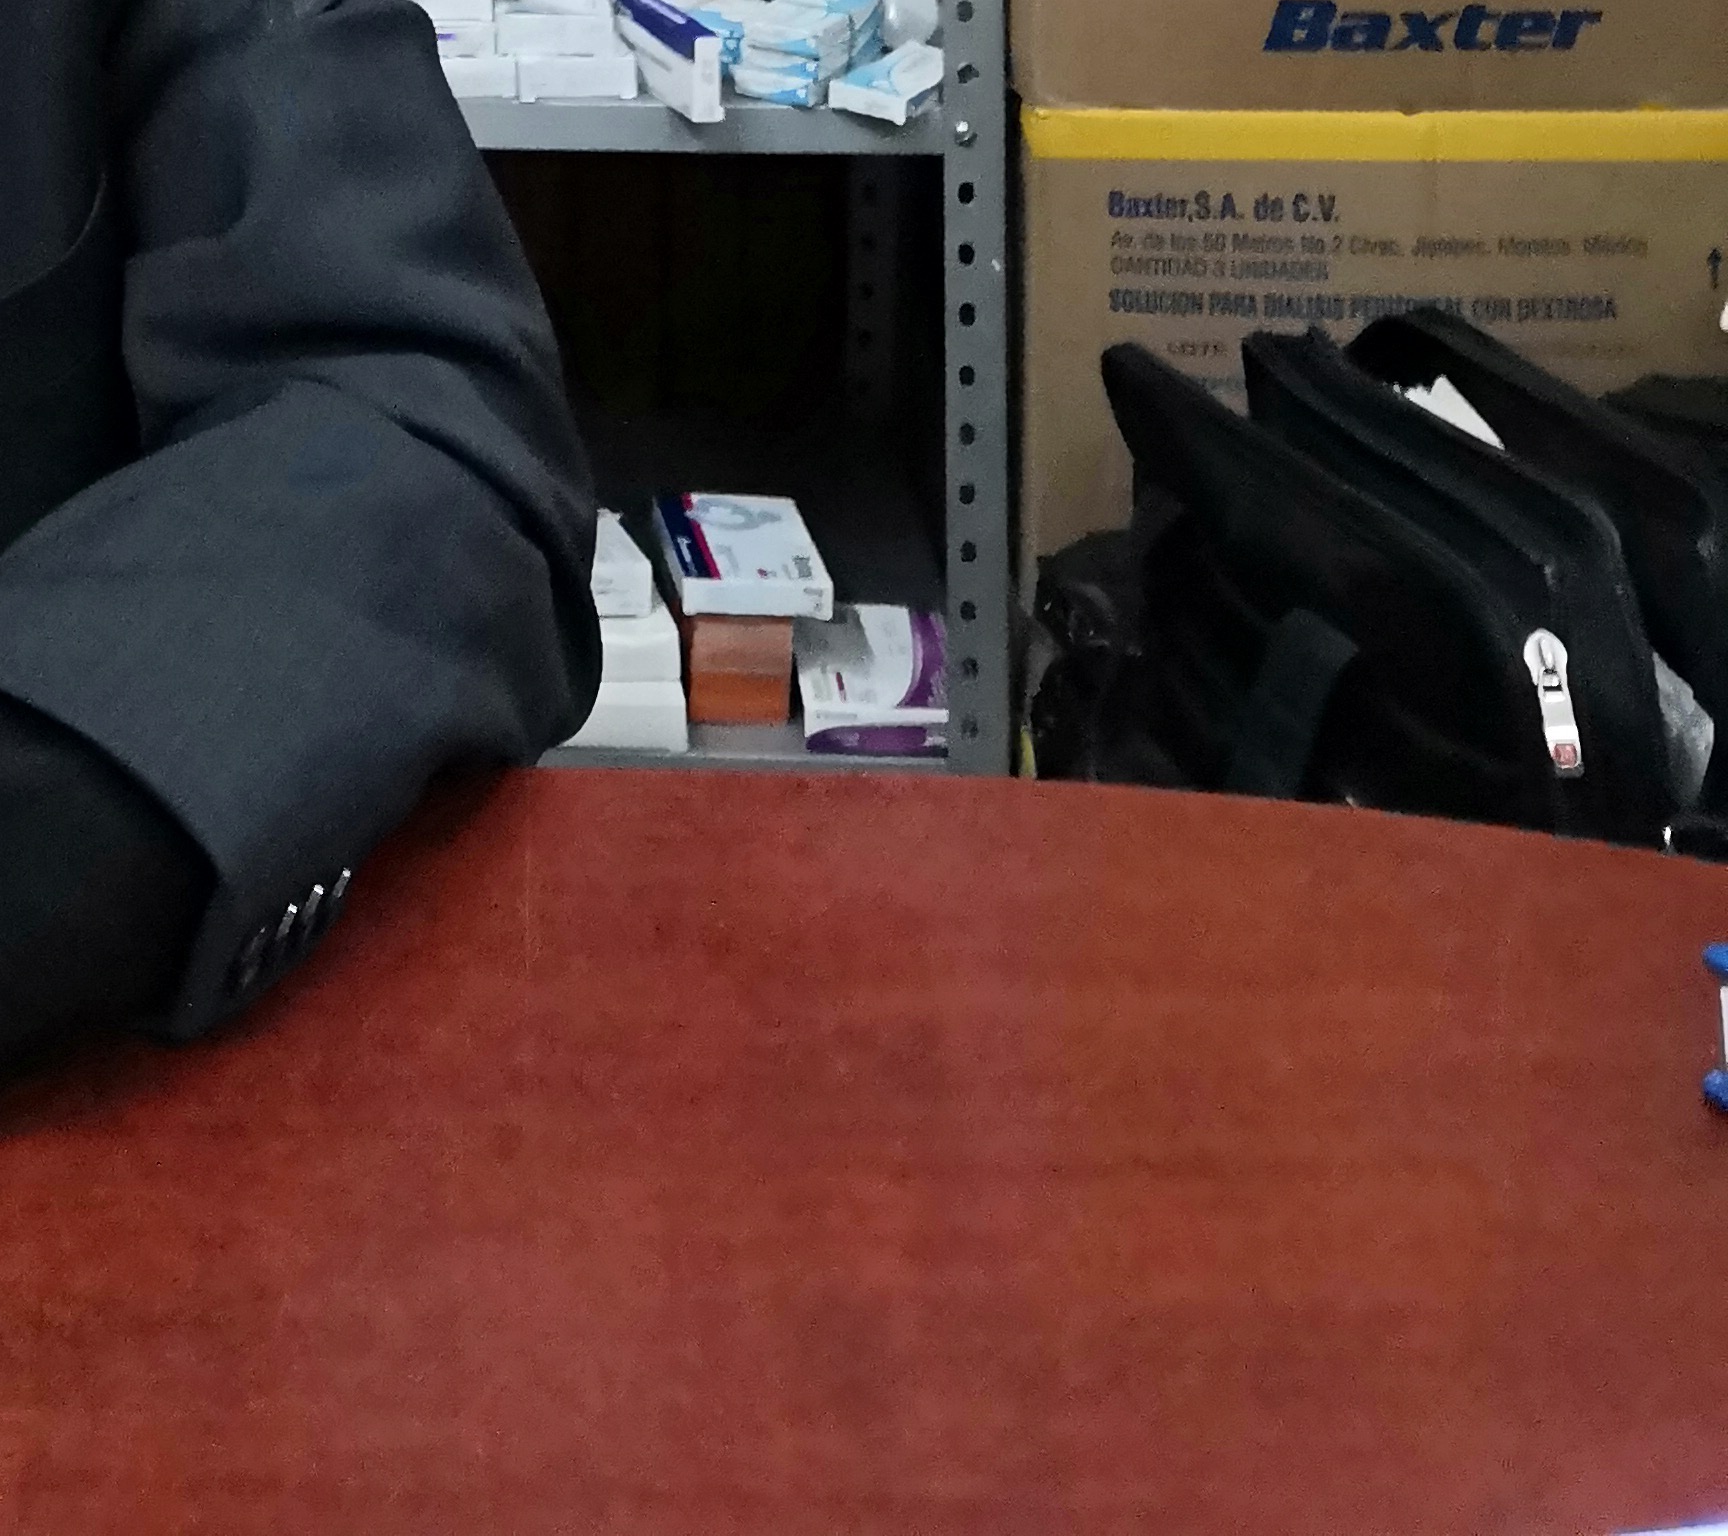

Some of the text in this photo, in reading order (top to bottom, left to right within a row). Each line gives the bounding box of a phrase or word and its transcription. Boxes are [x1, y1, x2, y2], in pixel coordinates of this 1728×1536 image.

[1253, 193, 1284, 222] de
[1292, 193, 1339, 223] C.V.
[1109, 288, 1203, 315] SOLUCION
[1208, 290, 1256, 317] PARA
